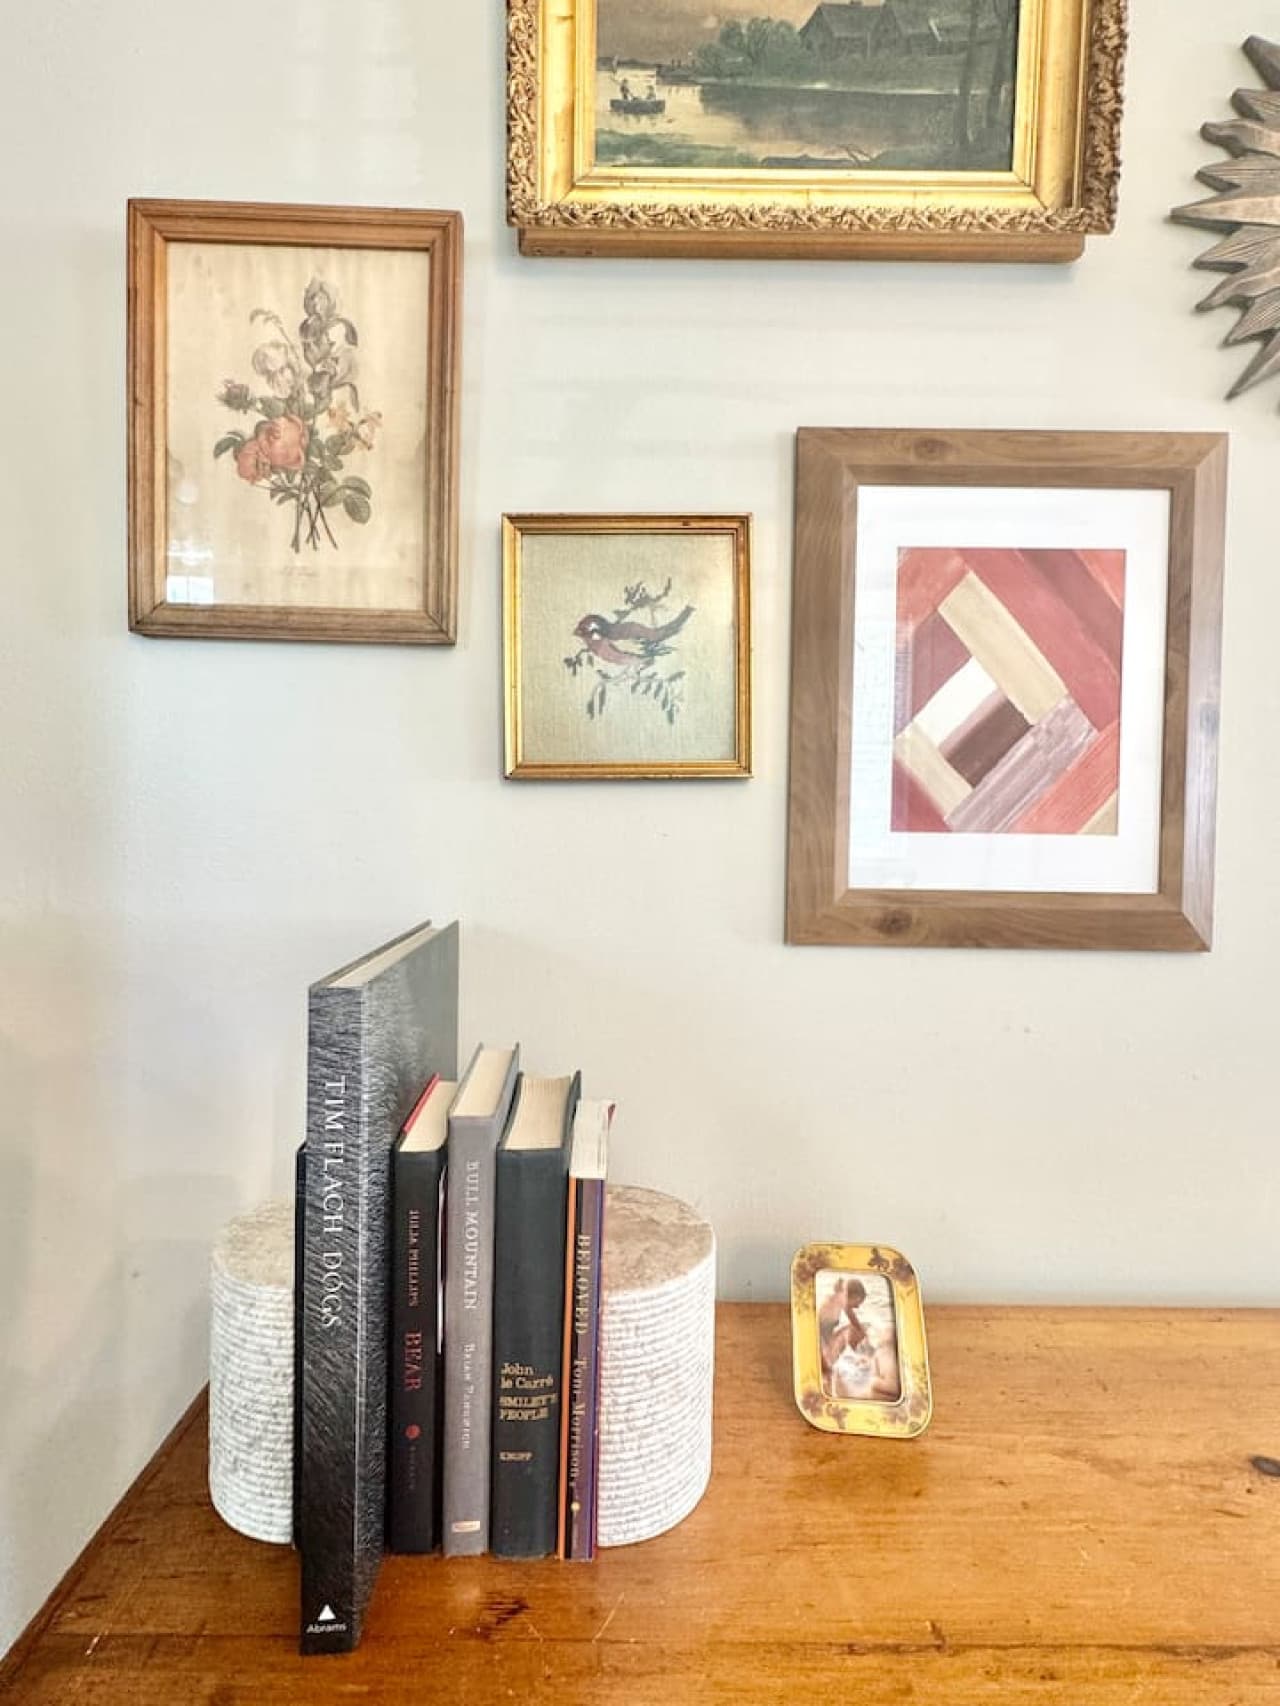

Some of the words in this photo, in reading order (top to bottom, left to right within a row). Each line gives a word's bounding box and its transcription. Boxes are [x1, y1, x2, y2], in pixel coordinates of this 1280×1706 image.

[324, 1074, 346, 1131] TIM
[322, 1142, 345, 1233] FLACH
[463, 1160, 480, 1207] BULL
[320, 1252, 344, 1329] DOGS
[463, 1211, 480, 1309] MOUNTAIN
[575, 1234, 592, 1335] BELOVED
[403, 1331, 424, 1392] BEAR
[500, 1362, 535, 1376] John
[499, 1408, 549, 1421] PEOPLE
